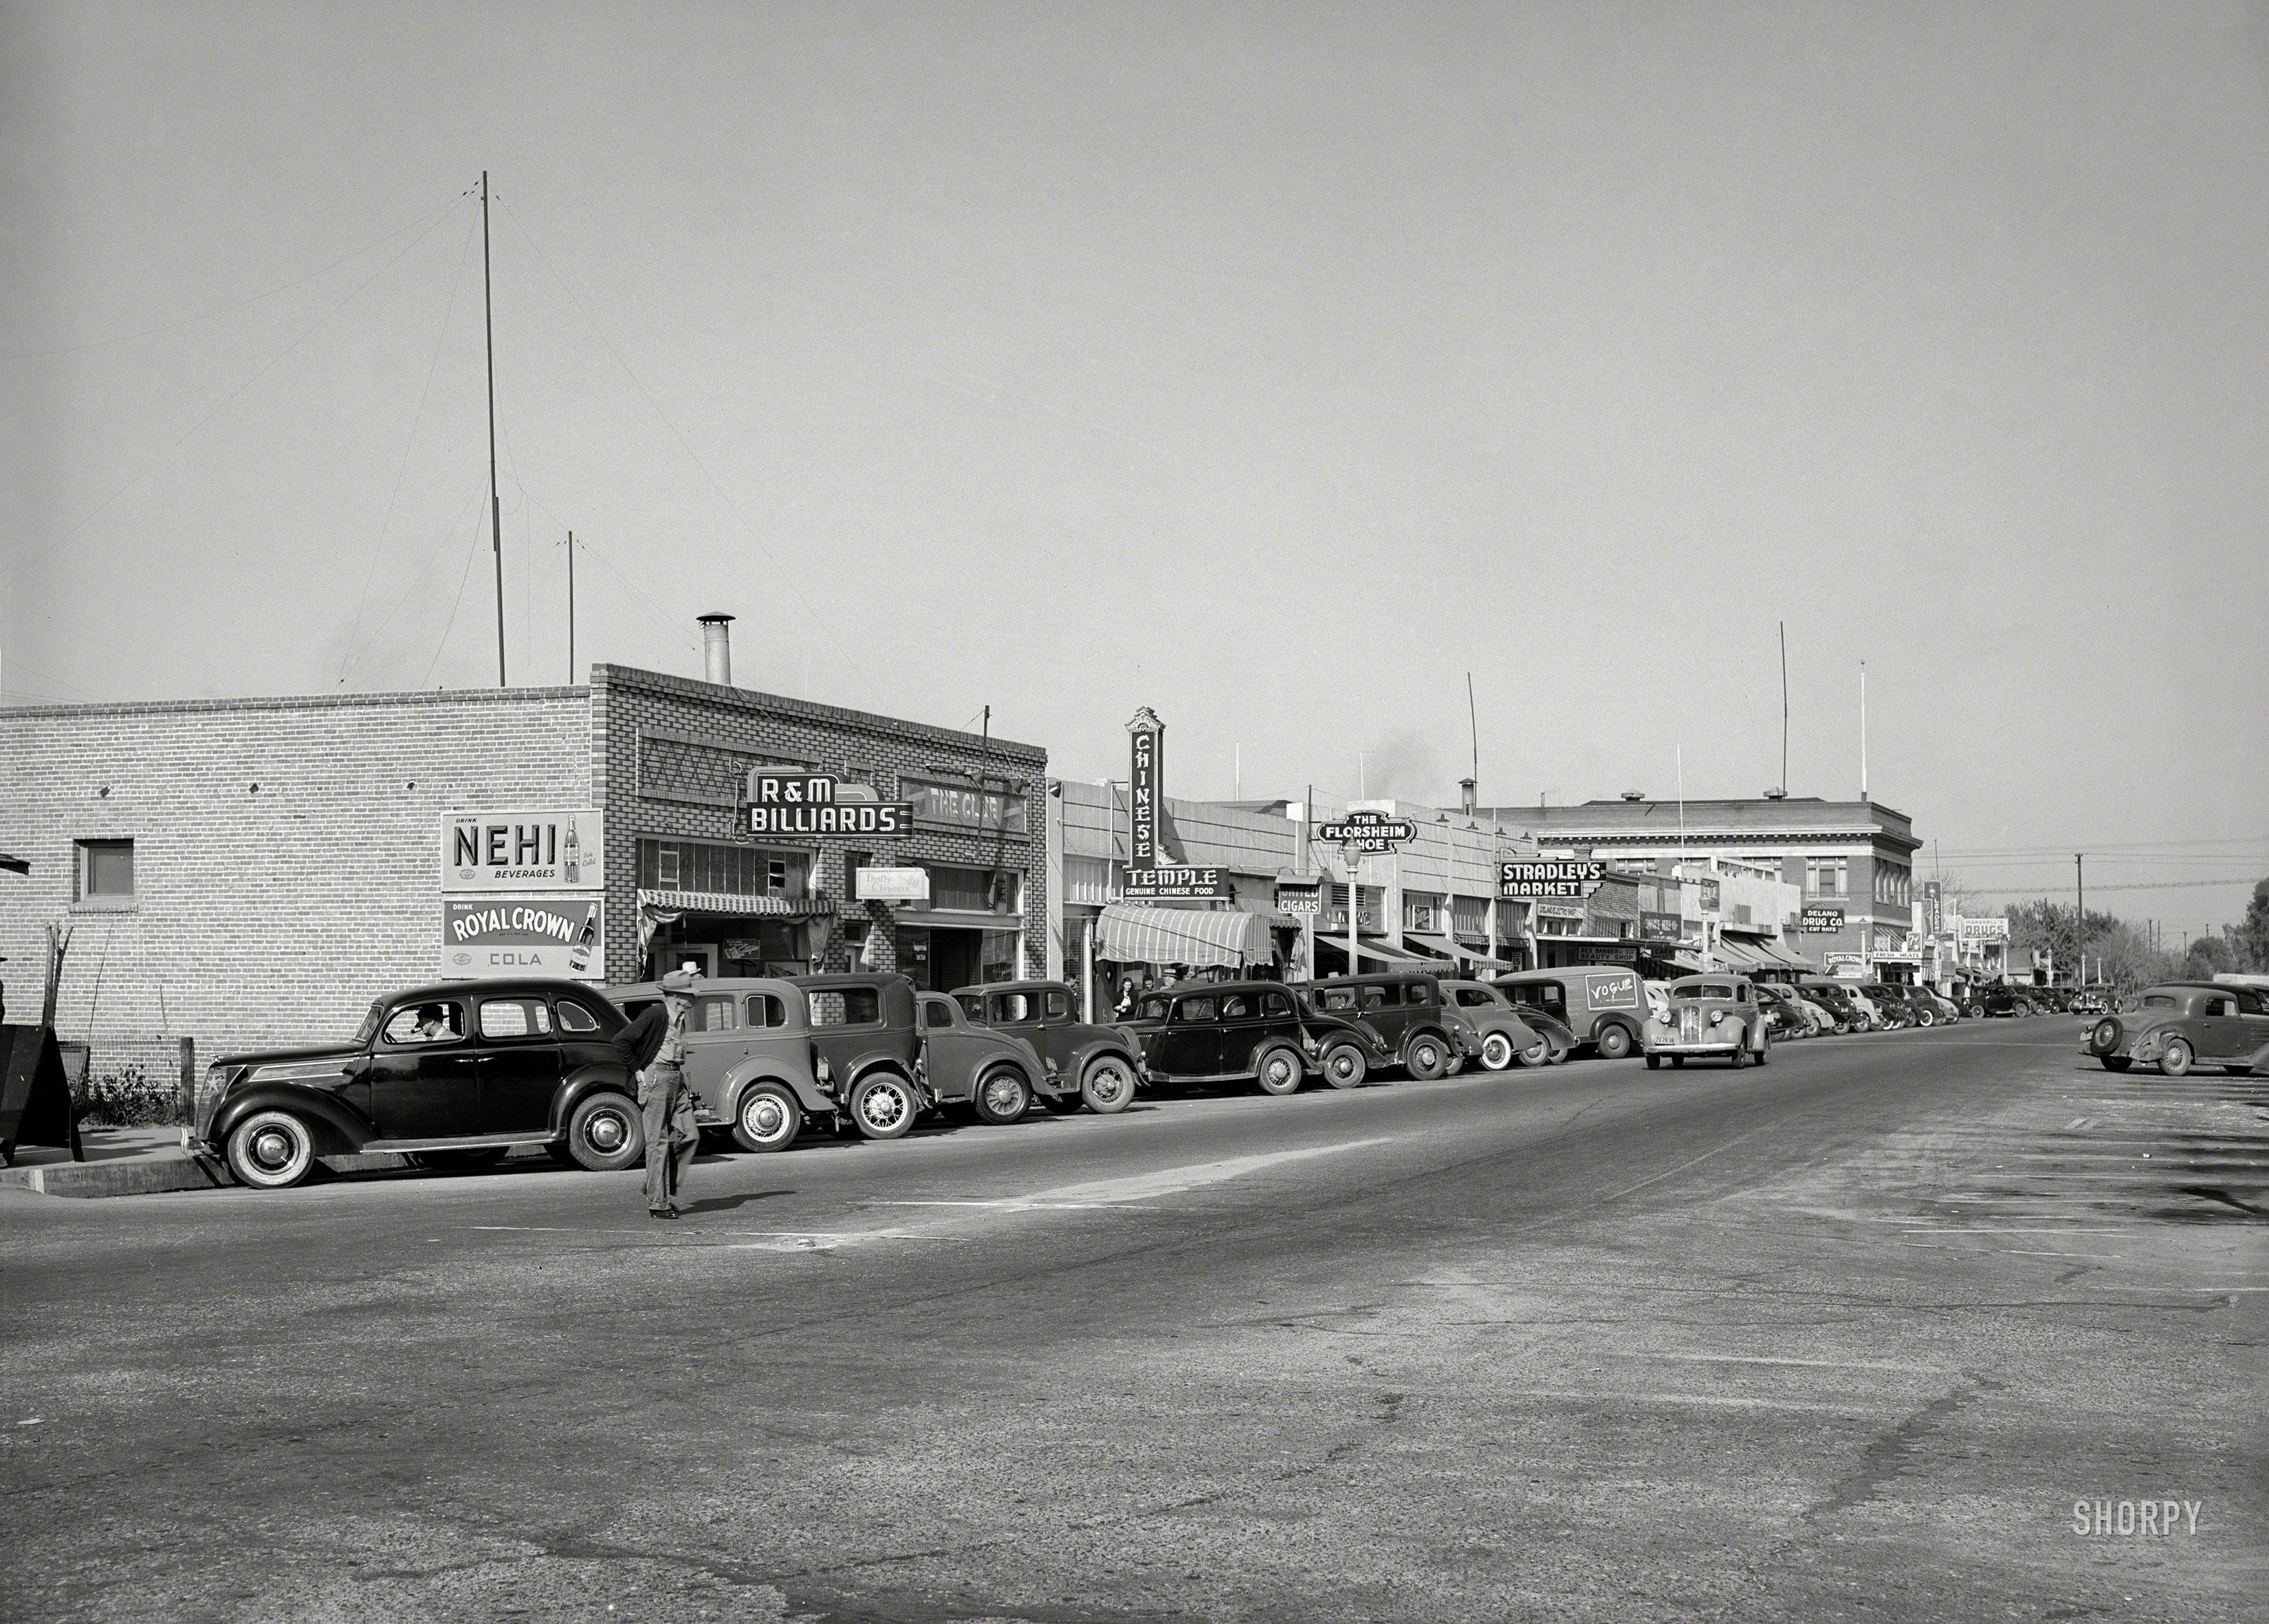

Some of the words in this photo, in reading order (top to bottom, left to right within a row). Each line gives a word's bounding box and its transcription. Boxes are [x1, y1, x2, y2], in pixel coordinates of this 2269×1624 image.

[1134, 734, 1151, 857] CHINESE
[930, 787, 958, 819] THE
[752, 807, 896, 832] BILLIARDS
[1354, 815, 1377, 824] THE
[1326, 826, 1405, 837] FLORSHEIM
[454, 824, 556, 866] NEHI
[1357, 839, 1385, 851] HOE
[582, 859, 596, 867] Cold
[494, 869, 556, 879] BEVERAGES
[1503, 862, 1601, 880] STRADLEY'S
[1126, 869, 1218, 886] TEMPLE
[1126, 887, 1156, 895] GENUINE
[1159, 887, 1190, 895] CHINESE
[1194, 887, 1214, 895] FOOD
[1282, 887, 1319, 898] UNITED
[1503, 882, 1579, 895] MARKET
[1281, 900, 1319, 913] CIGARS
[452, 908, 510, 942] ROYAL
[512, 906, 576, 943] CROWN
[1802, 917, 1827, 926] DRUG
[1830, 918, 1843, 926] CO.
[1966, 925, 2004, 934] DRUGS
[490, 953, 542, 965] COLA
[1828, 955, 1844, 964] ROYAL
